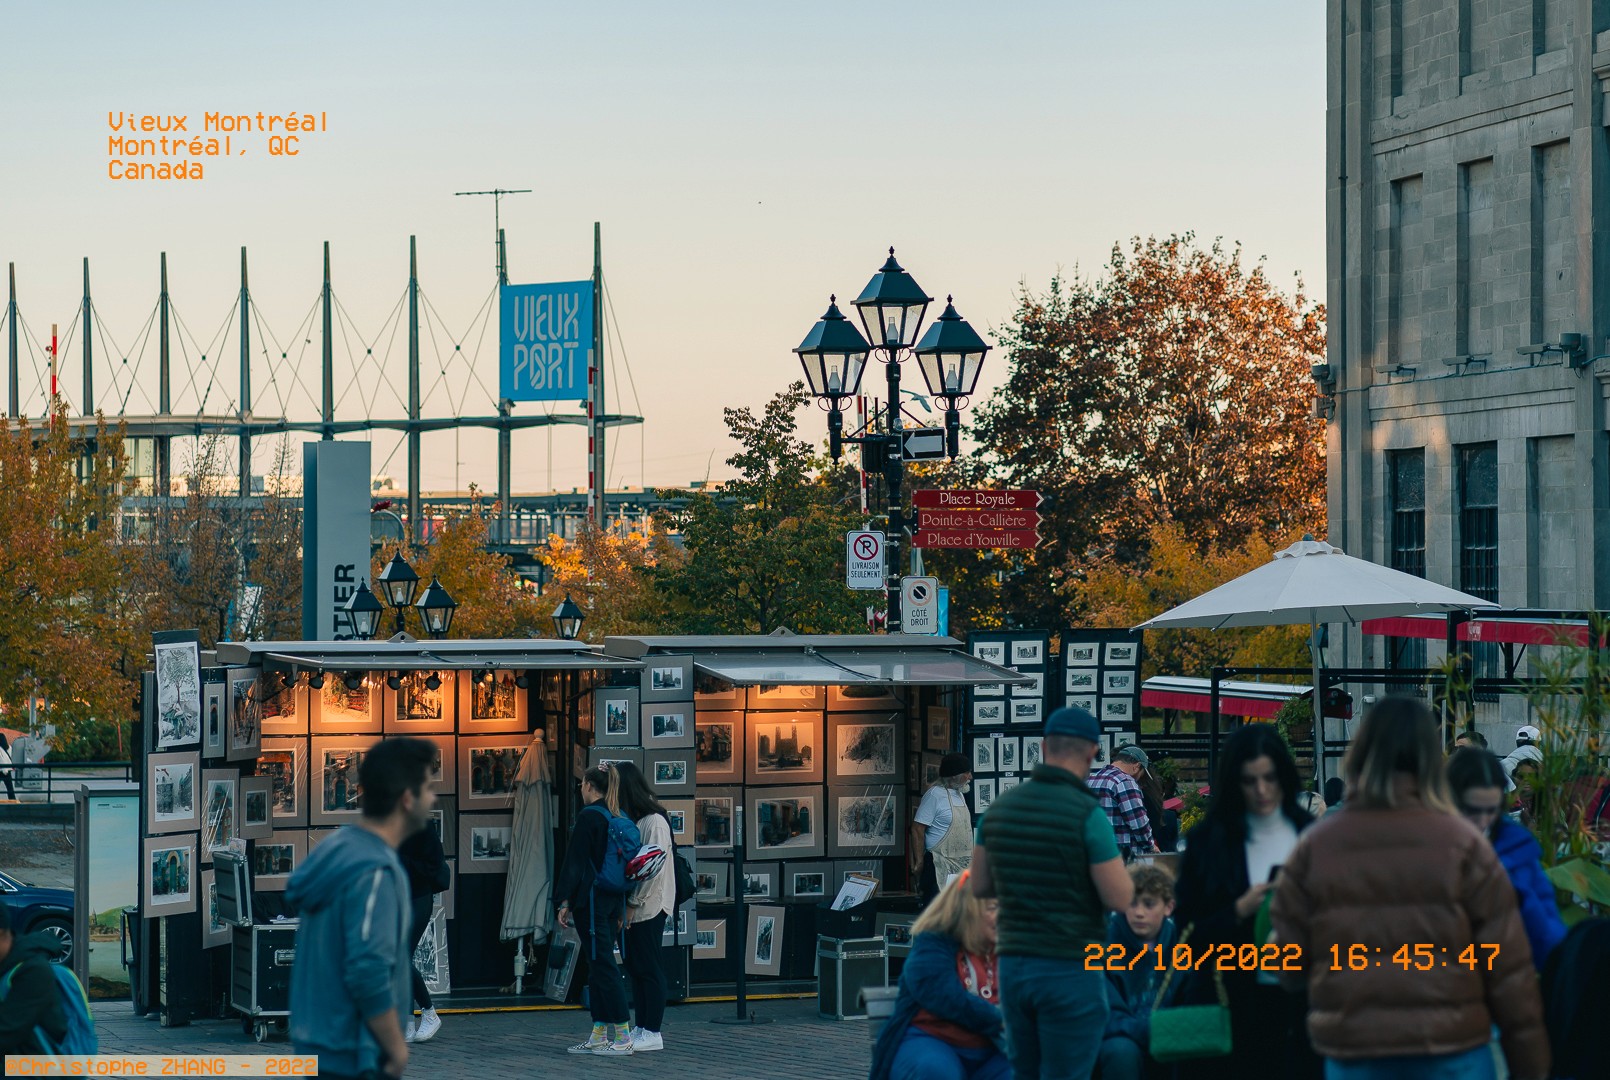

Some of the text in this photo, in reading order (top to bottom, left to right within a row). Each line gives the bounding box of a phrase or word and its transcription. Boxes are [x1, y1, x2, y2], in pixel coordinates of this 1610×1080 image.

[514, 293, 579, 342] VIEUX
[513, 341, 579, 391] PORT
[939, 492, 1016, 509] Place Royale
[922, 513, 1027, 526] Pointe-à-Callière
[927, 533, 1021, 546] Place d'Youville
[852, 561, 880, 570] LIVRAISON
[850, 570, 881, 579] SEULEMENT
[911, 607, 928, 618] CÔTÉ
[910, 618, 929, 626] DROIT
